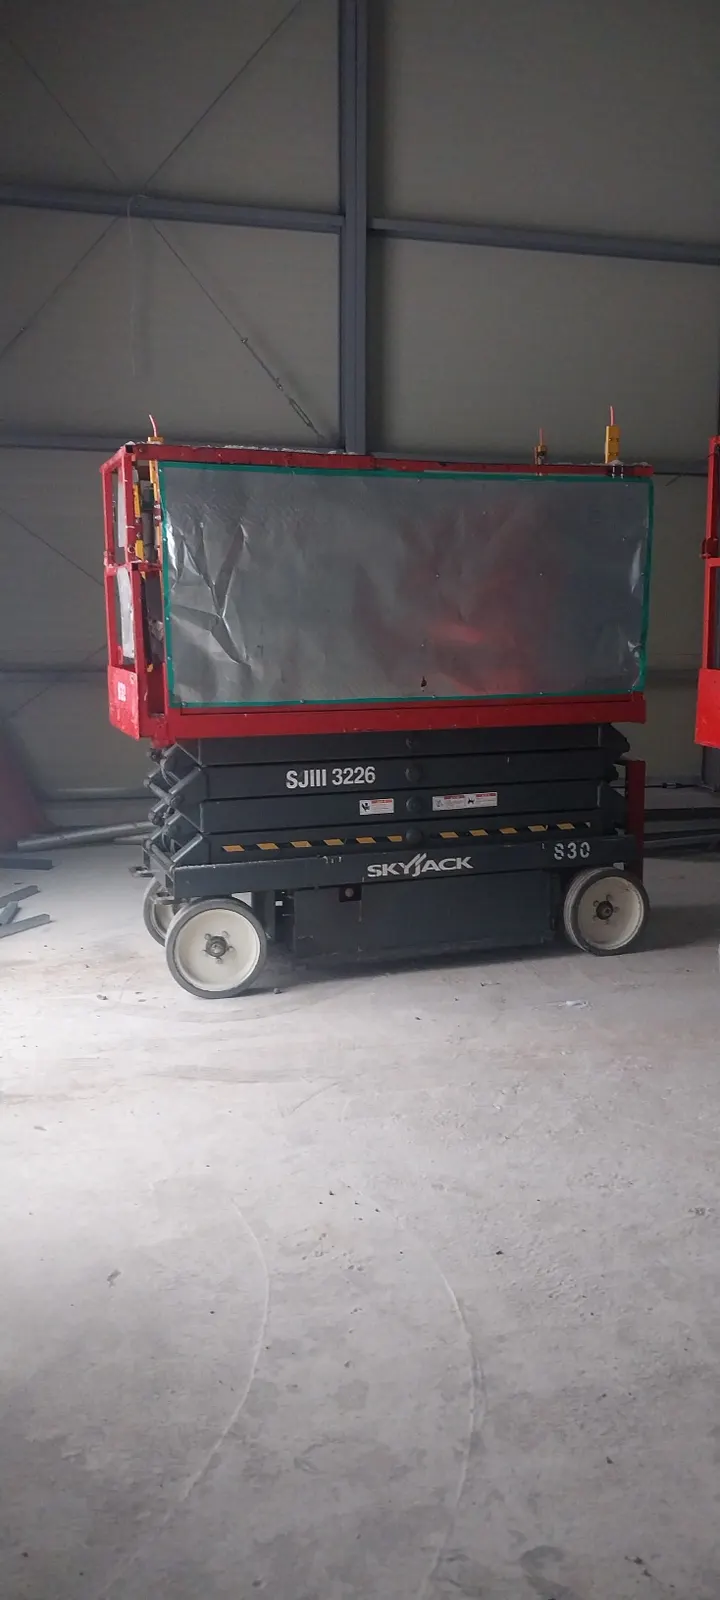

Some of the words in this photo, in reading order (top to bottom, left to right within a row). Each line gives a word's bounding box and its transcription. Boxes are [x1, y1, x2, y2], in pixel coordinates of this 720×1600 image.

[286, 769, 327, 789] SJIII
[332, 766, 376, 786] 3226
[367, 853, 474, 878] SKYJACK
